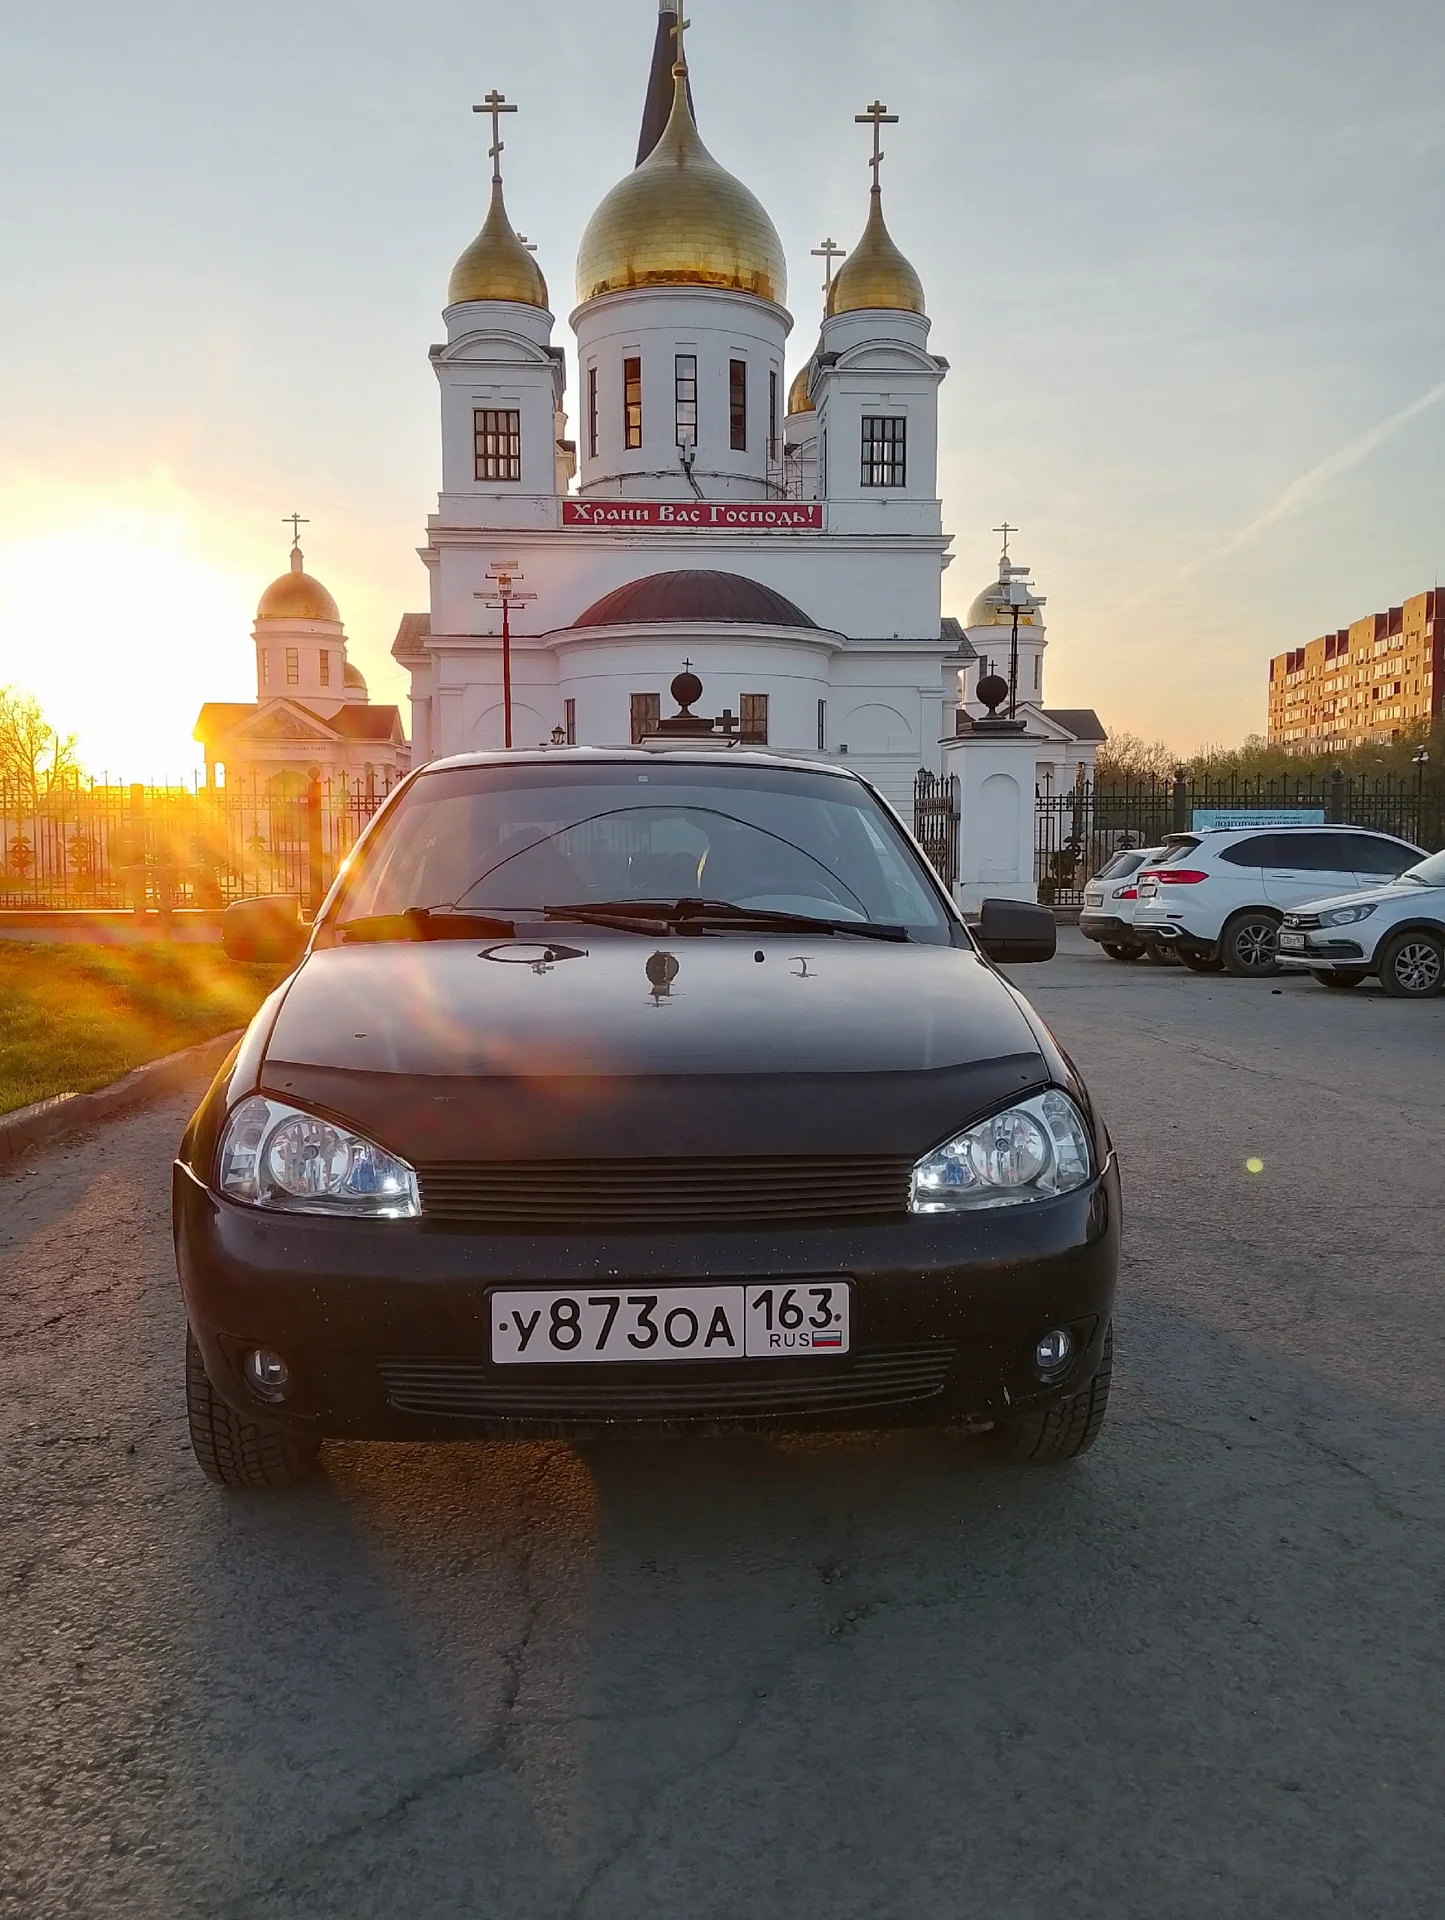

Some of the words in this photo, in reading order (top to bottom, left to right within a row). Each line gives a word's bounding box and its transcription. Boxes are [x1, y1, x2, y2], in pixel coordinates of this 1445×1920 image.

[572, 503, 649, 524] Храни
[658, 505, 700, 522] Вас
[709, 505, 814, 526] Господь!
[511, 1295, 736, 1352] У873ОА
[752, 1288, 833, 1331] 163
[769, 1332, 810, 1348] RUS
